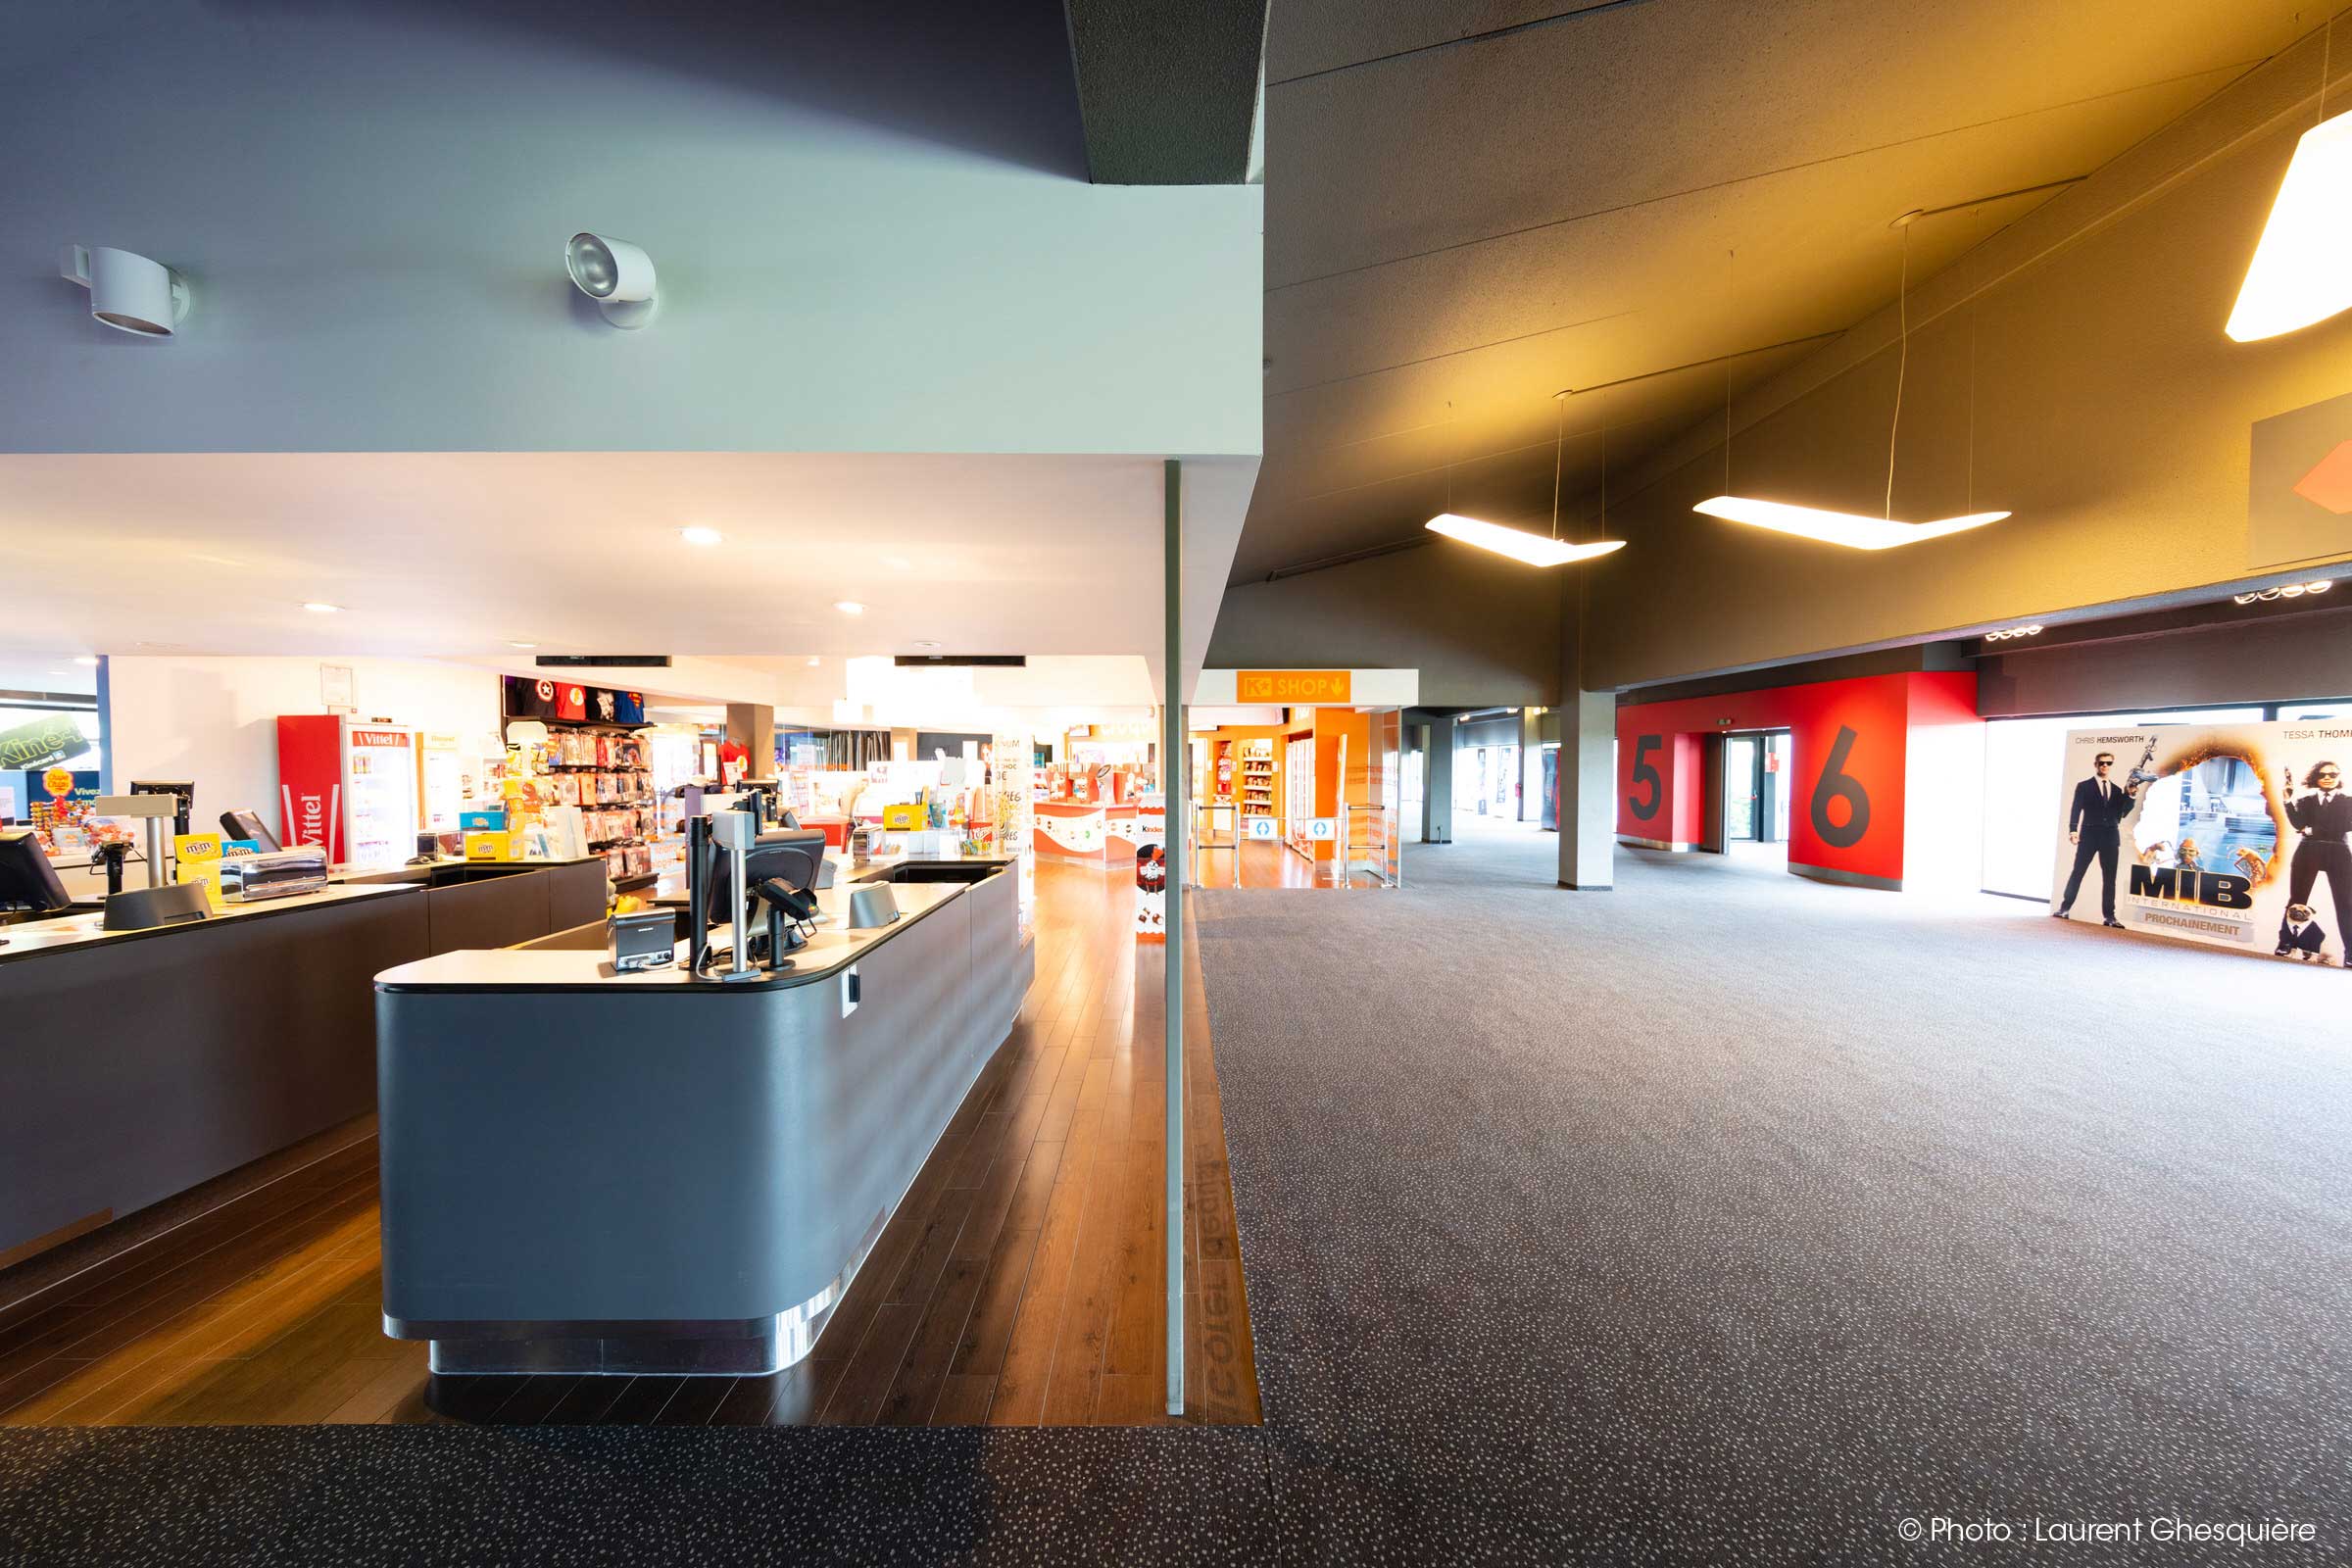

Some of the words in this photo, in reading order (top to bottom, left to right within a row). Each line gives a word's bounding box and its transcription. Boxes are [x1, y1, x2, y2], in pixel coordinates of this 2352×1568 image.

[1277, 678, 1327, 696] SHOP
[365, 733, 393, 745] Vittel
[2096, 735, 2144, 744] HEMSWORTH
[2282, 730, 2315, 739] TESSA
[2319, 729, 2352, 738] THOM
[1629, 734, 1662, 820] 5
[1810, 724, 1871, 849] 6
[2130, 864, 2253, 909] MIB
[2128, 896, 2253, 921] INTERNATIONAL
[2144, 912, 2240, 935] PROCHAINEMENT
